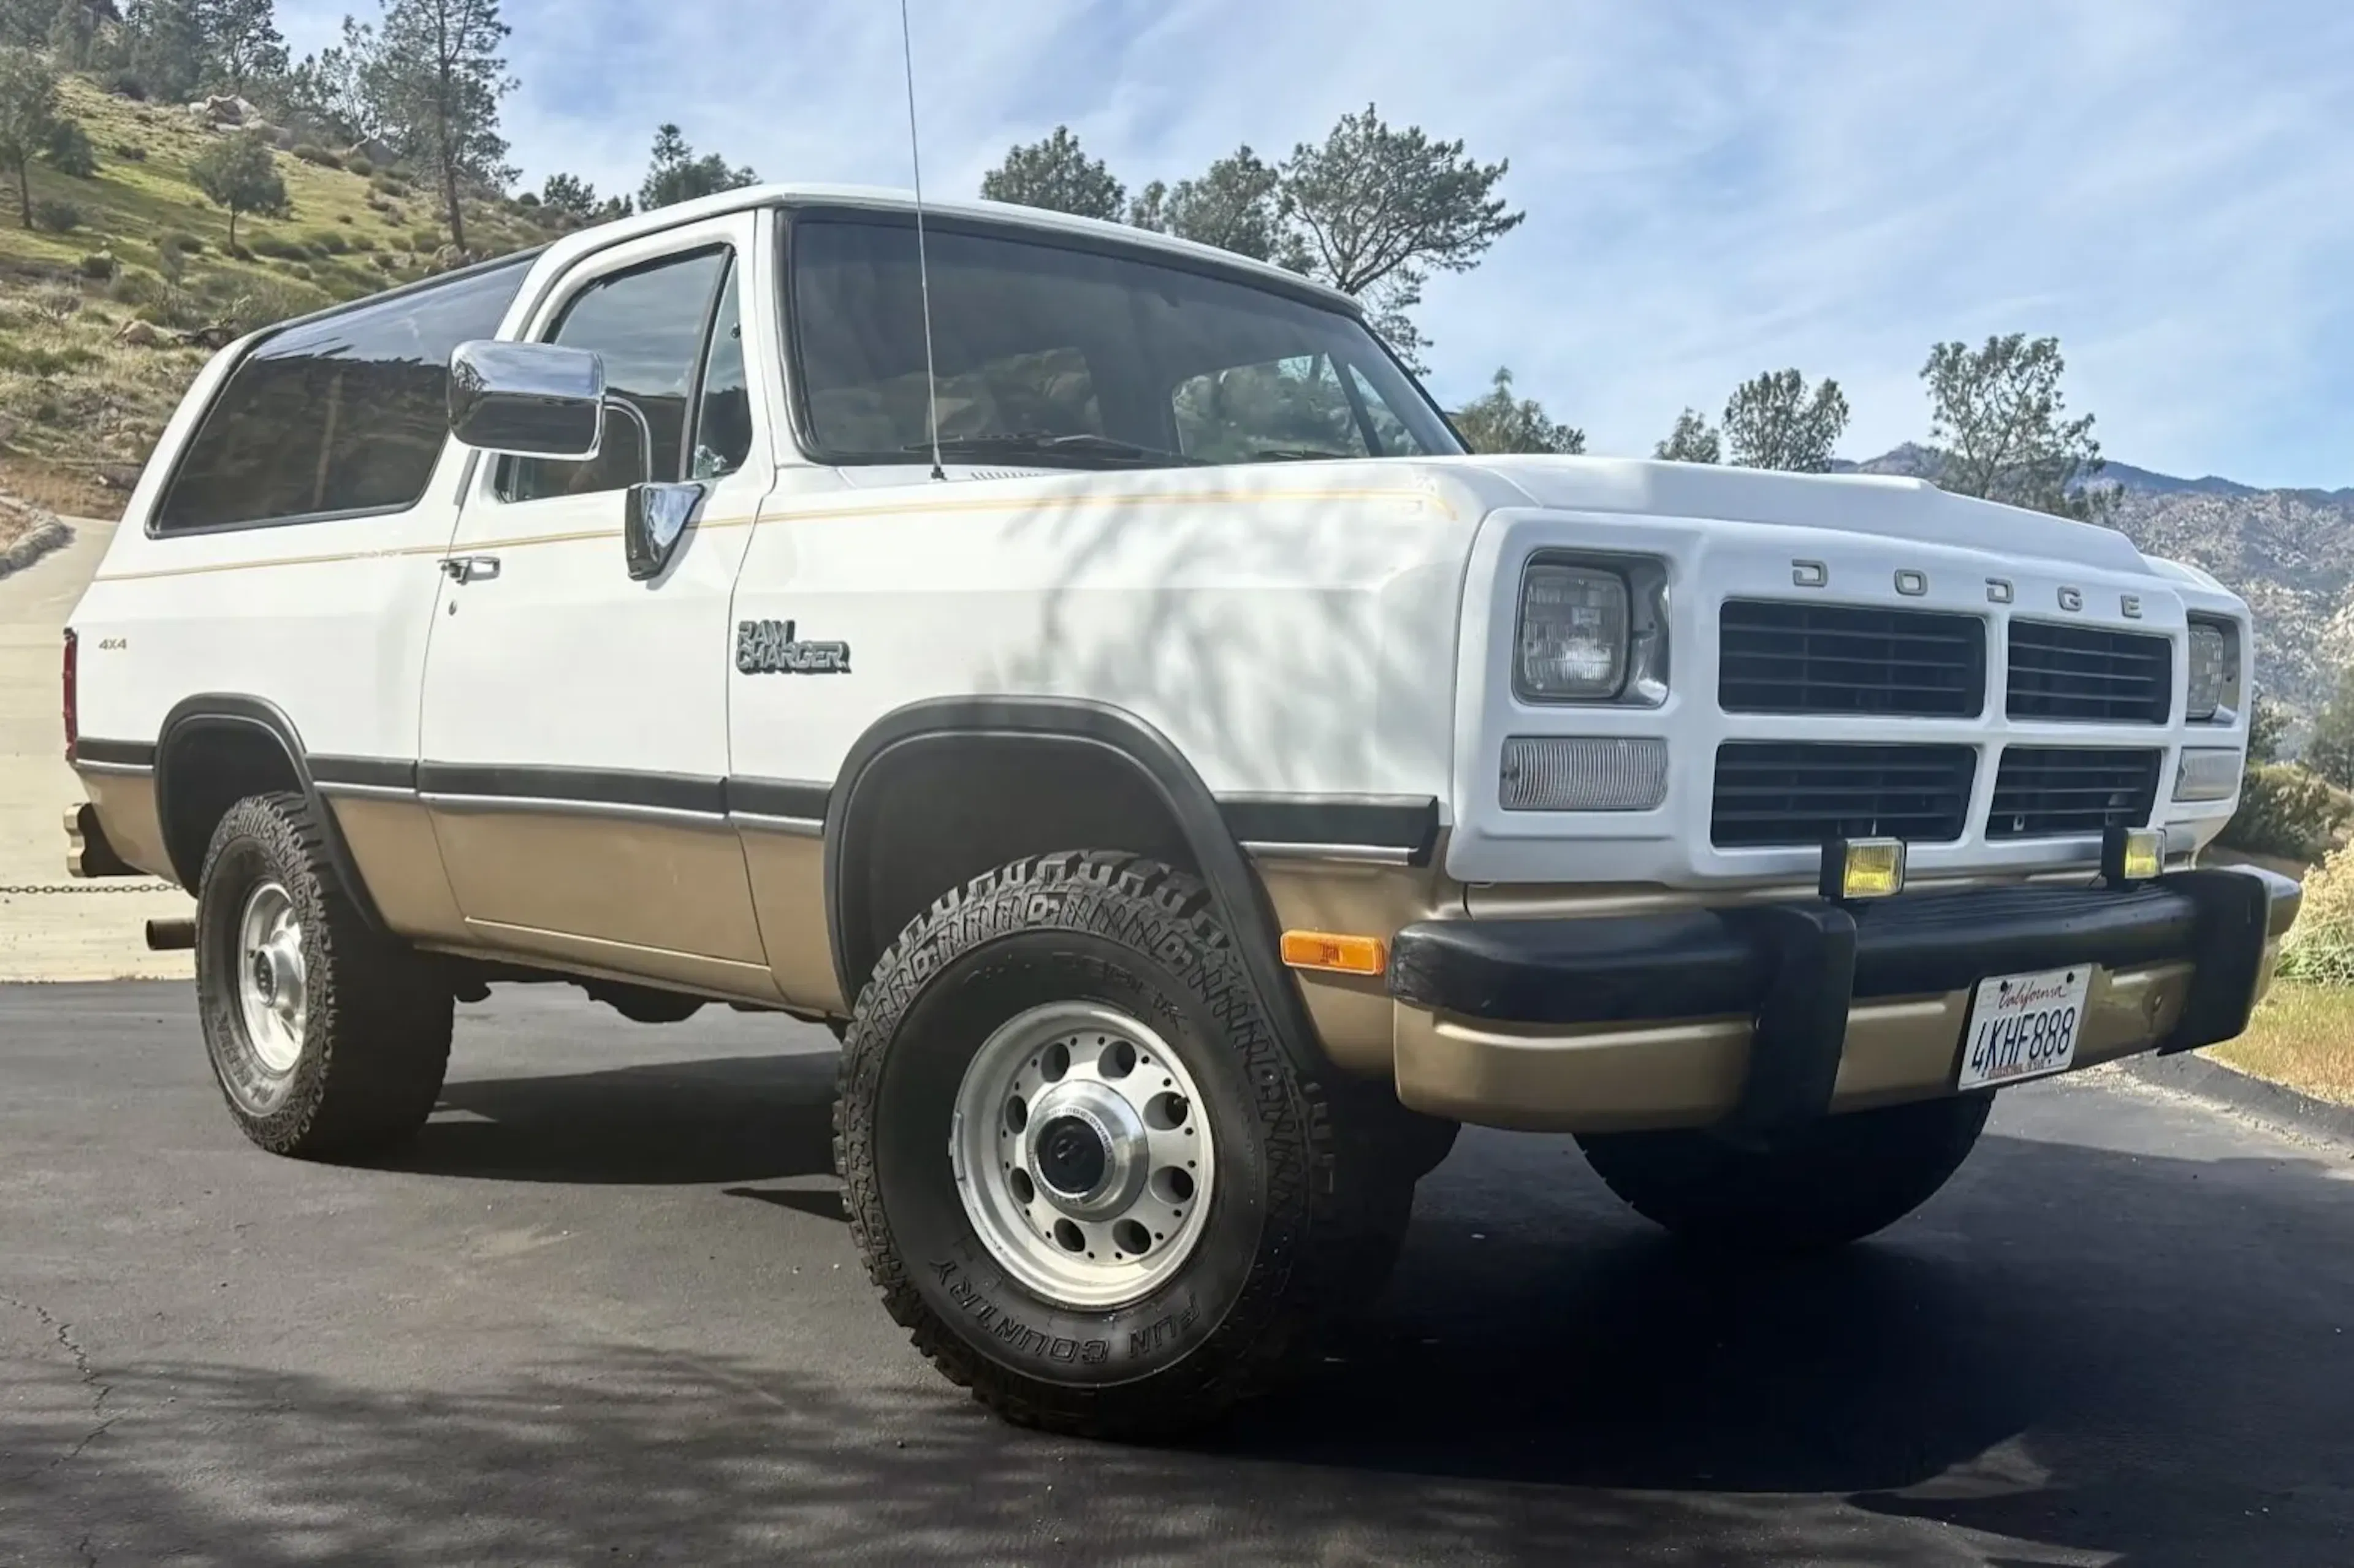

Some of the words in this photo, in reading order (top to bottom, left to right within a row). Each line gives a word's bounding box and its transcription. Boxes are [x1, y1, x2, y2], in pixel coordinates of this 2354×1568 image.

[1792, 558, 2143, 619] DODGE
[737, 620, 795, 645] RAM
[736, 641, 851, 675] CHARGER
[1998, 980, 2066, 1012] California
[1971, 1007, 2076, 1078] 4KHF888
[928, 1259, 1110, 1365] COUNTRY
